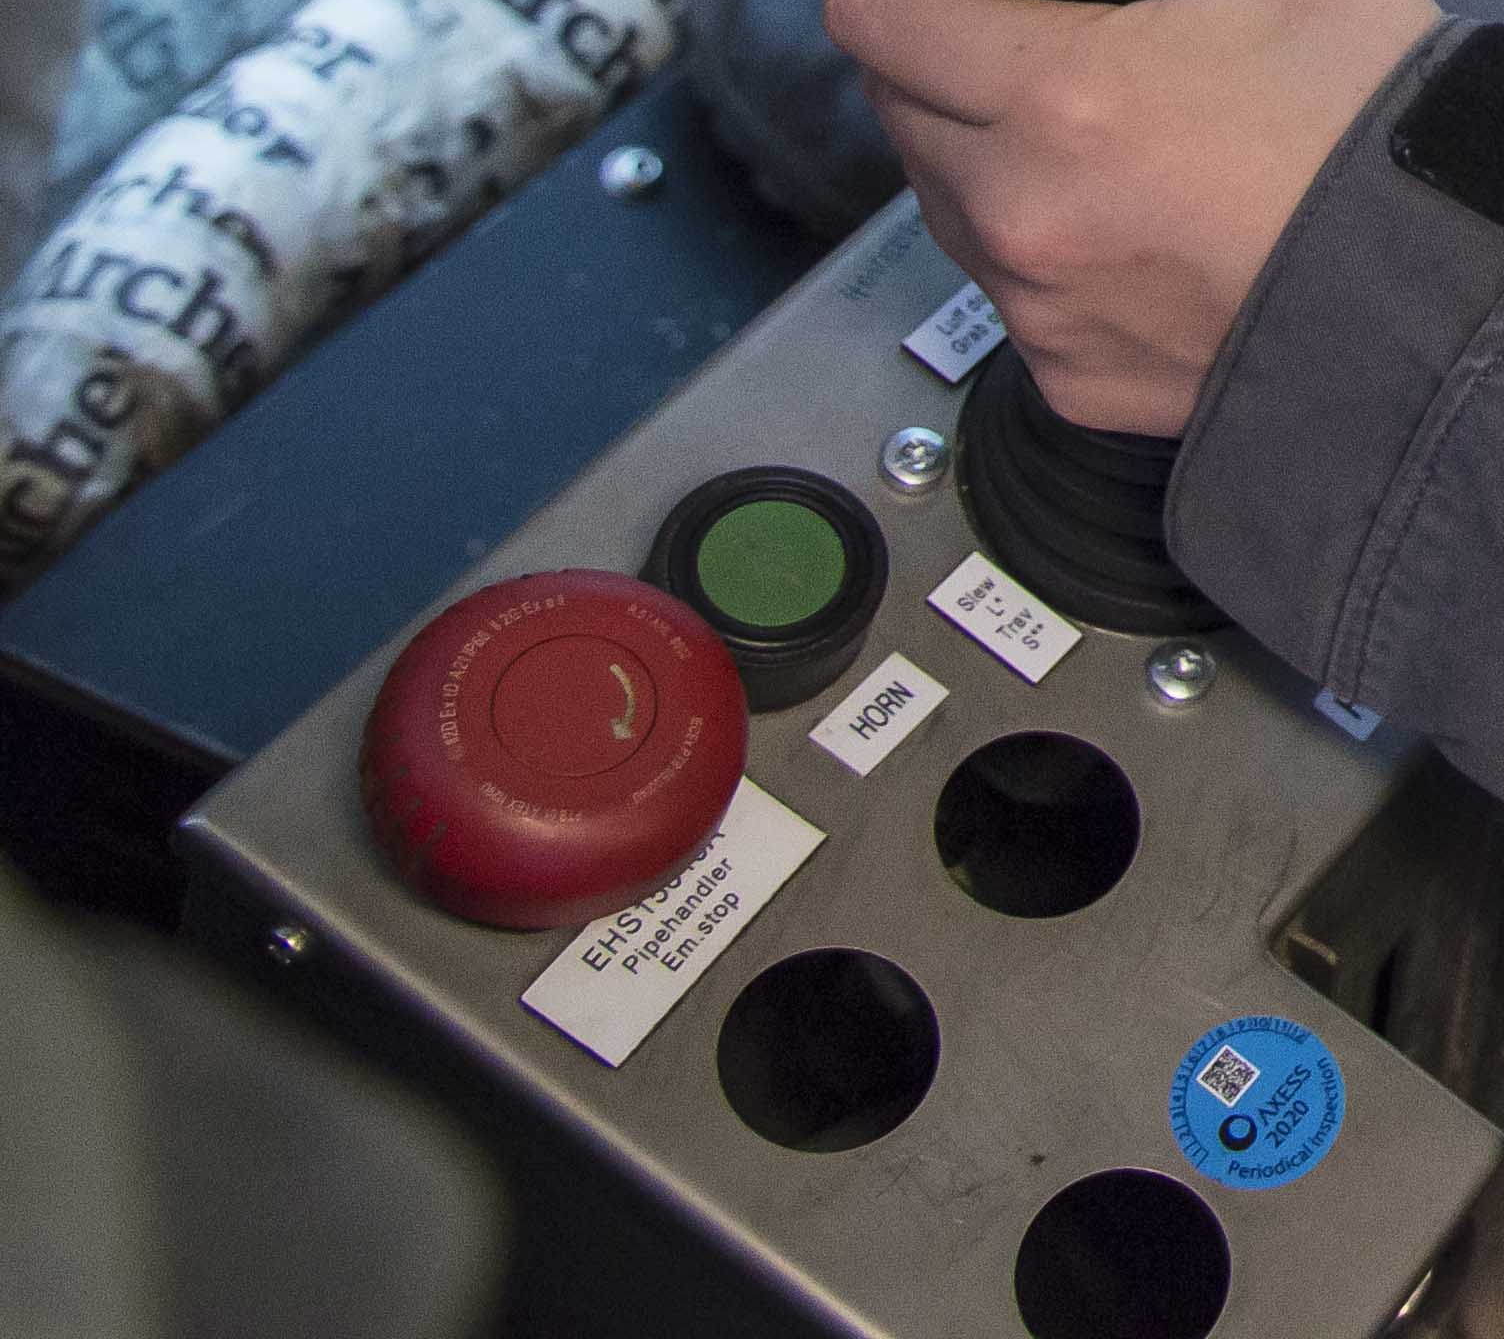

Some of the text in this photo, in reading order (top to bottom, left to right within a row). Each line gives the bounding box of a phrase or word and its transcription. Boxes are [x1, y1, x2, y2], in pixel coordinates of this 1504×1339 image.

[956, 576, 996, 612] Slew
[849, 681, 915, 740] HORN
[621, 857, 733, 975] Pipehandler
[660, 892, 739, 972] Em.stop
[1257, 1063, 1312, 1127] AXESS
[1264, 1100, 1310, 1148] 2020
[1228, 1142, 1313, 1180] Periodical
